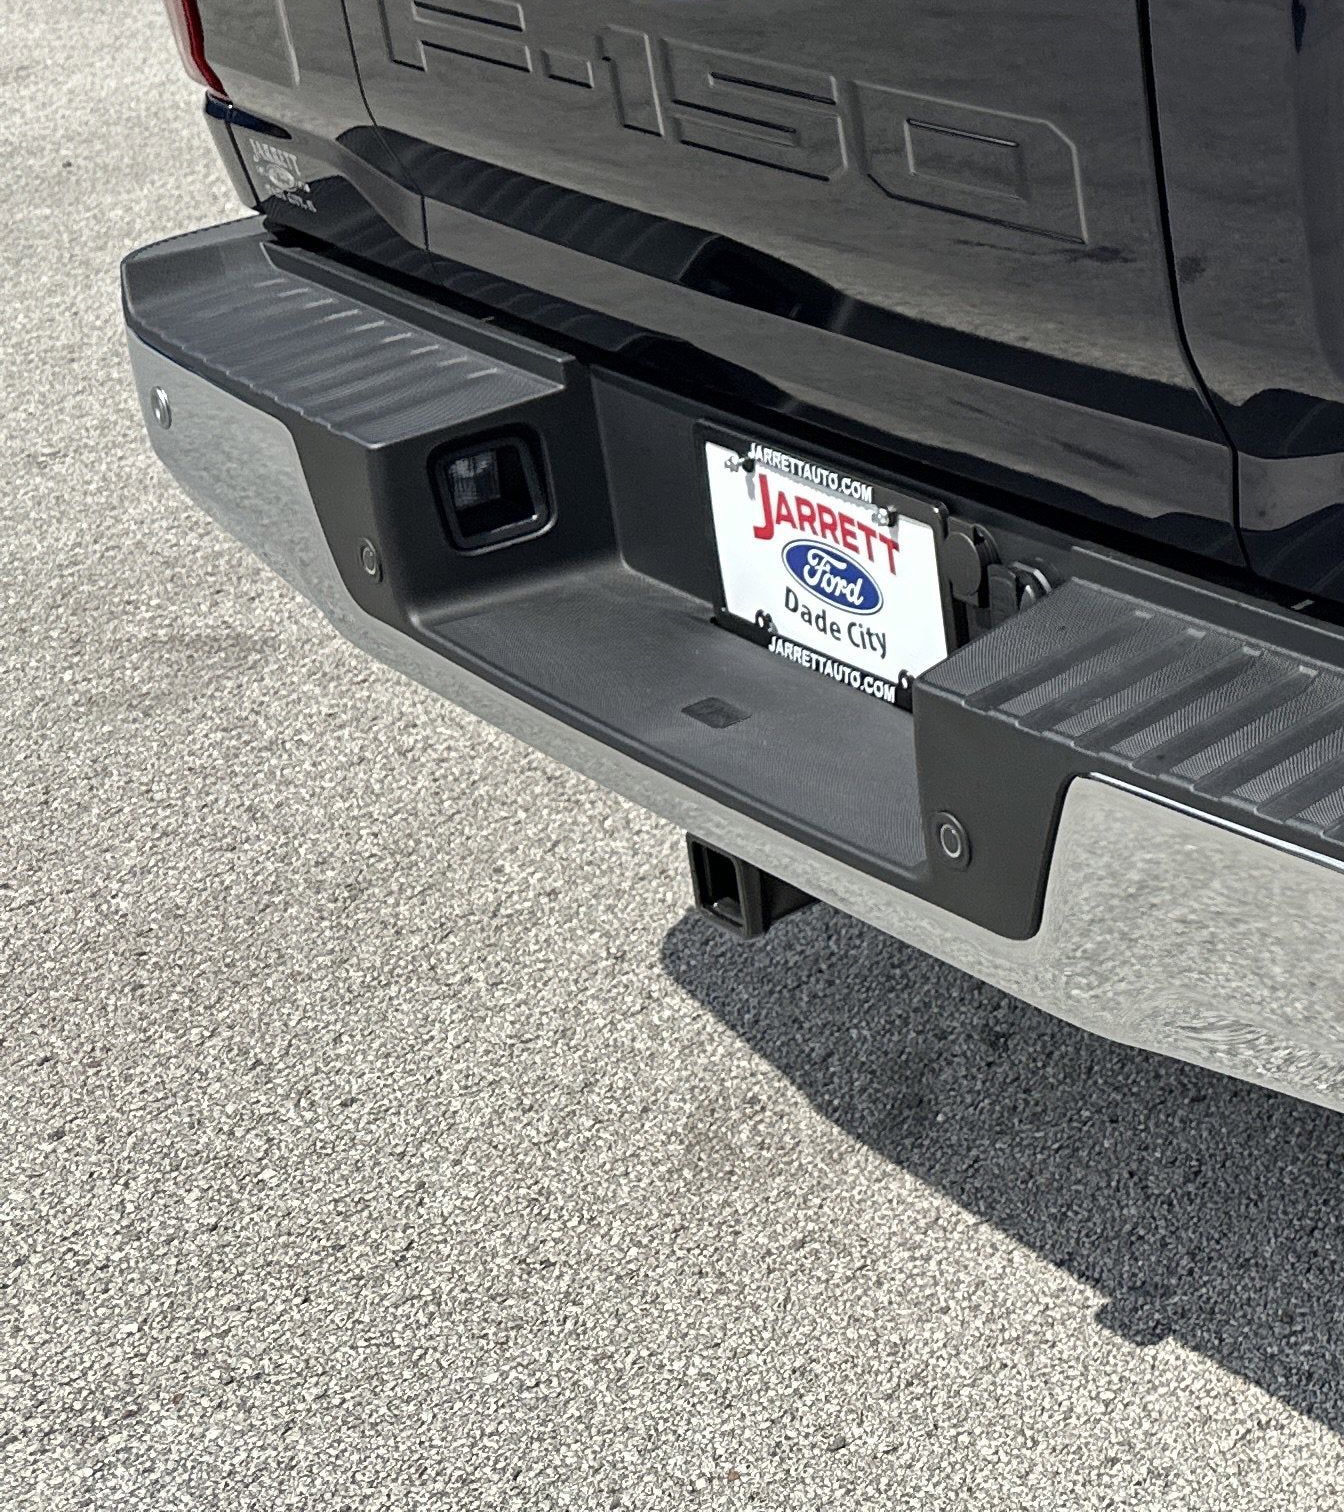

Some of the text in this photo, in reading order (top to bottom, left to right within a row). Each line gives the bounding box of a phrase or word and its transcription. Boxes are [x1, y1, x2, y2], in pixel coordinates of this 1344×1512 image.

[748, 442, 873, 504] JARRETTAUTO.COM
[753, 473, 900, 576] JARRETT
[803, 548, 864, 606] Ford
[785, 585, 887, 659] Dade City
[768, 635, 897, 704] JARRETTAUTO.COM
